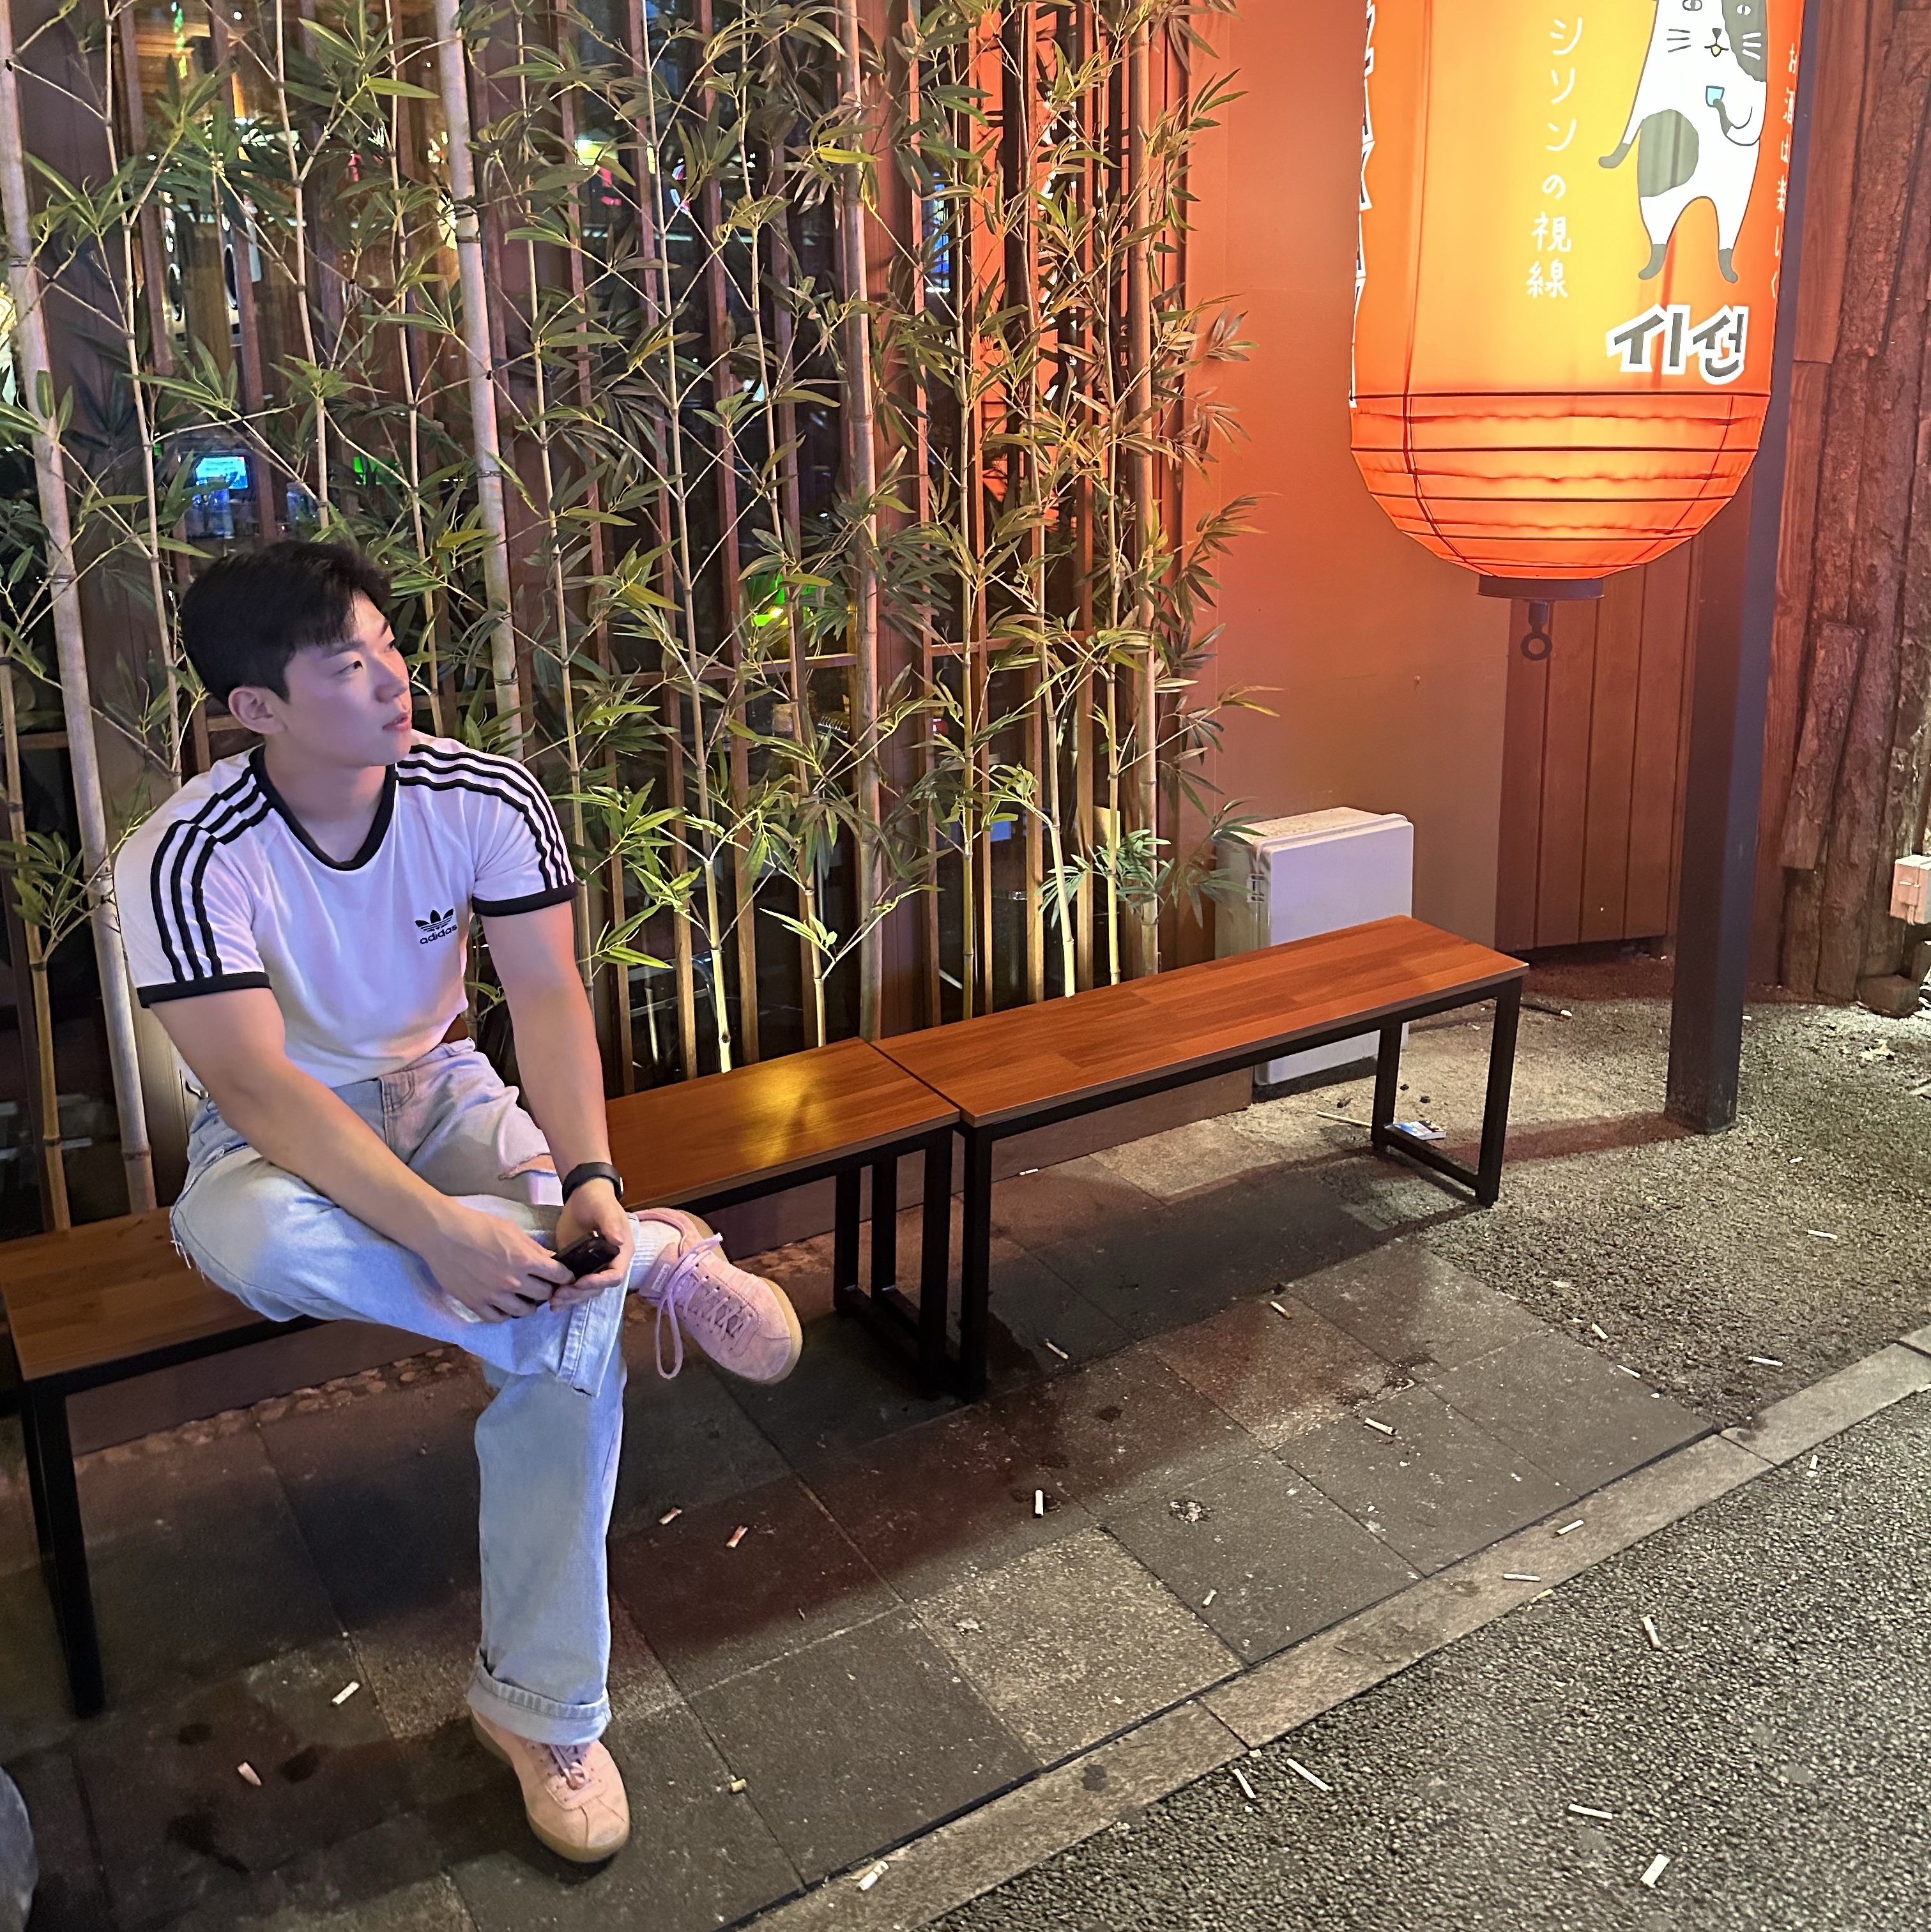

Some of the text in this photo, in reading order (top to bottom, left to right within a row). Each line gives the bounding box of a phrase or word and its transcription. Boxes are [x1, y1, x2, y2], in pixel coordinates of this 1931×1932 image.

[1525, 16, 1584, 299] シソンの視線
[1607, 305, 1748, 384] 시선
[420, 924, 457, 945] adidas
